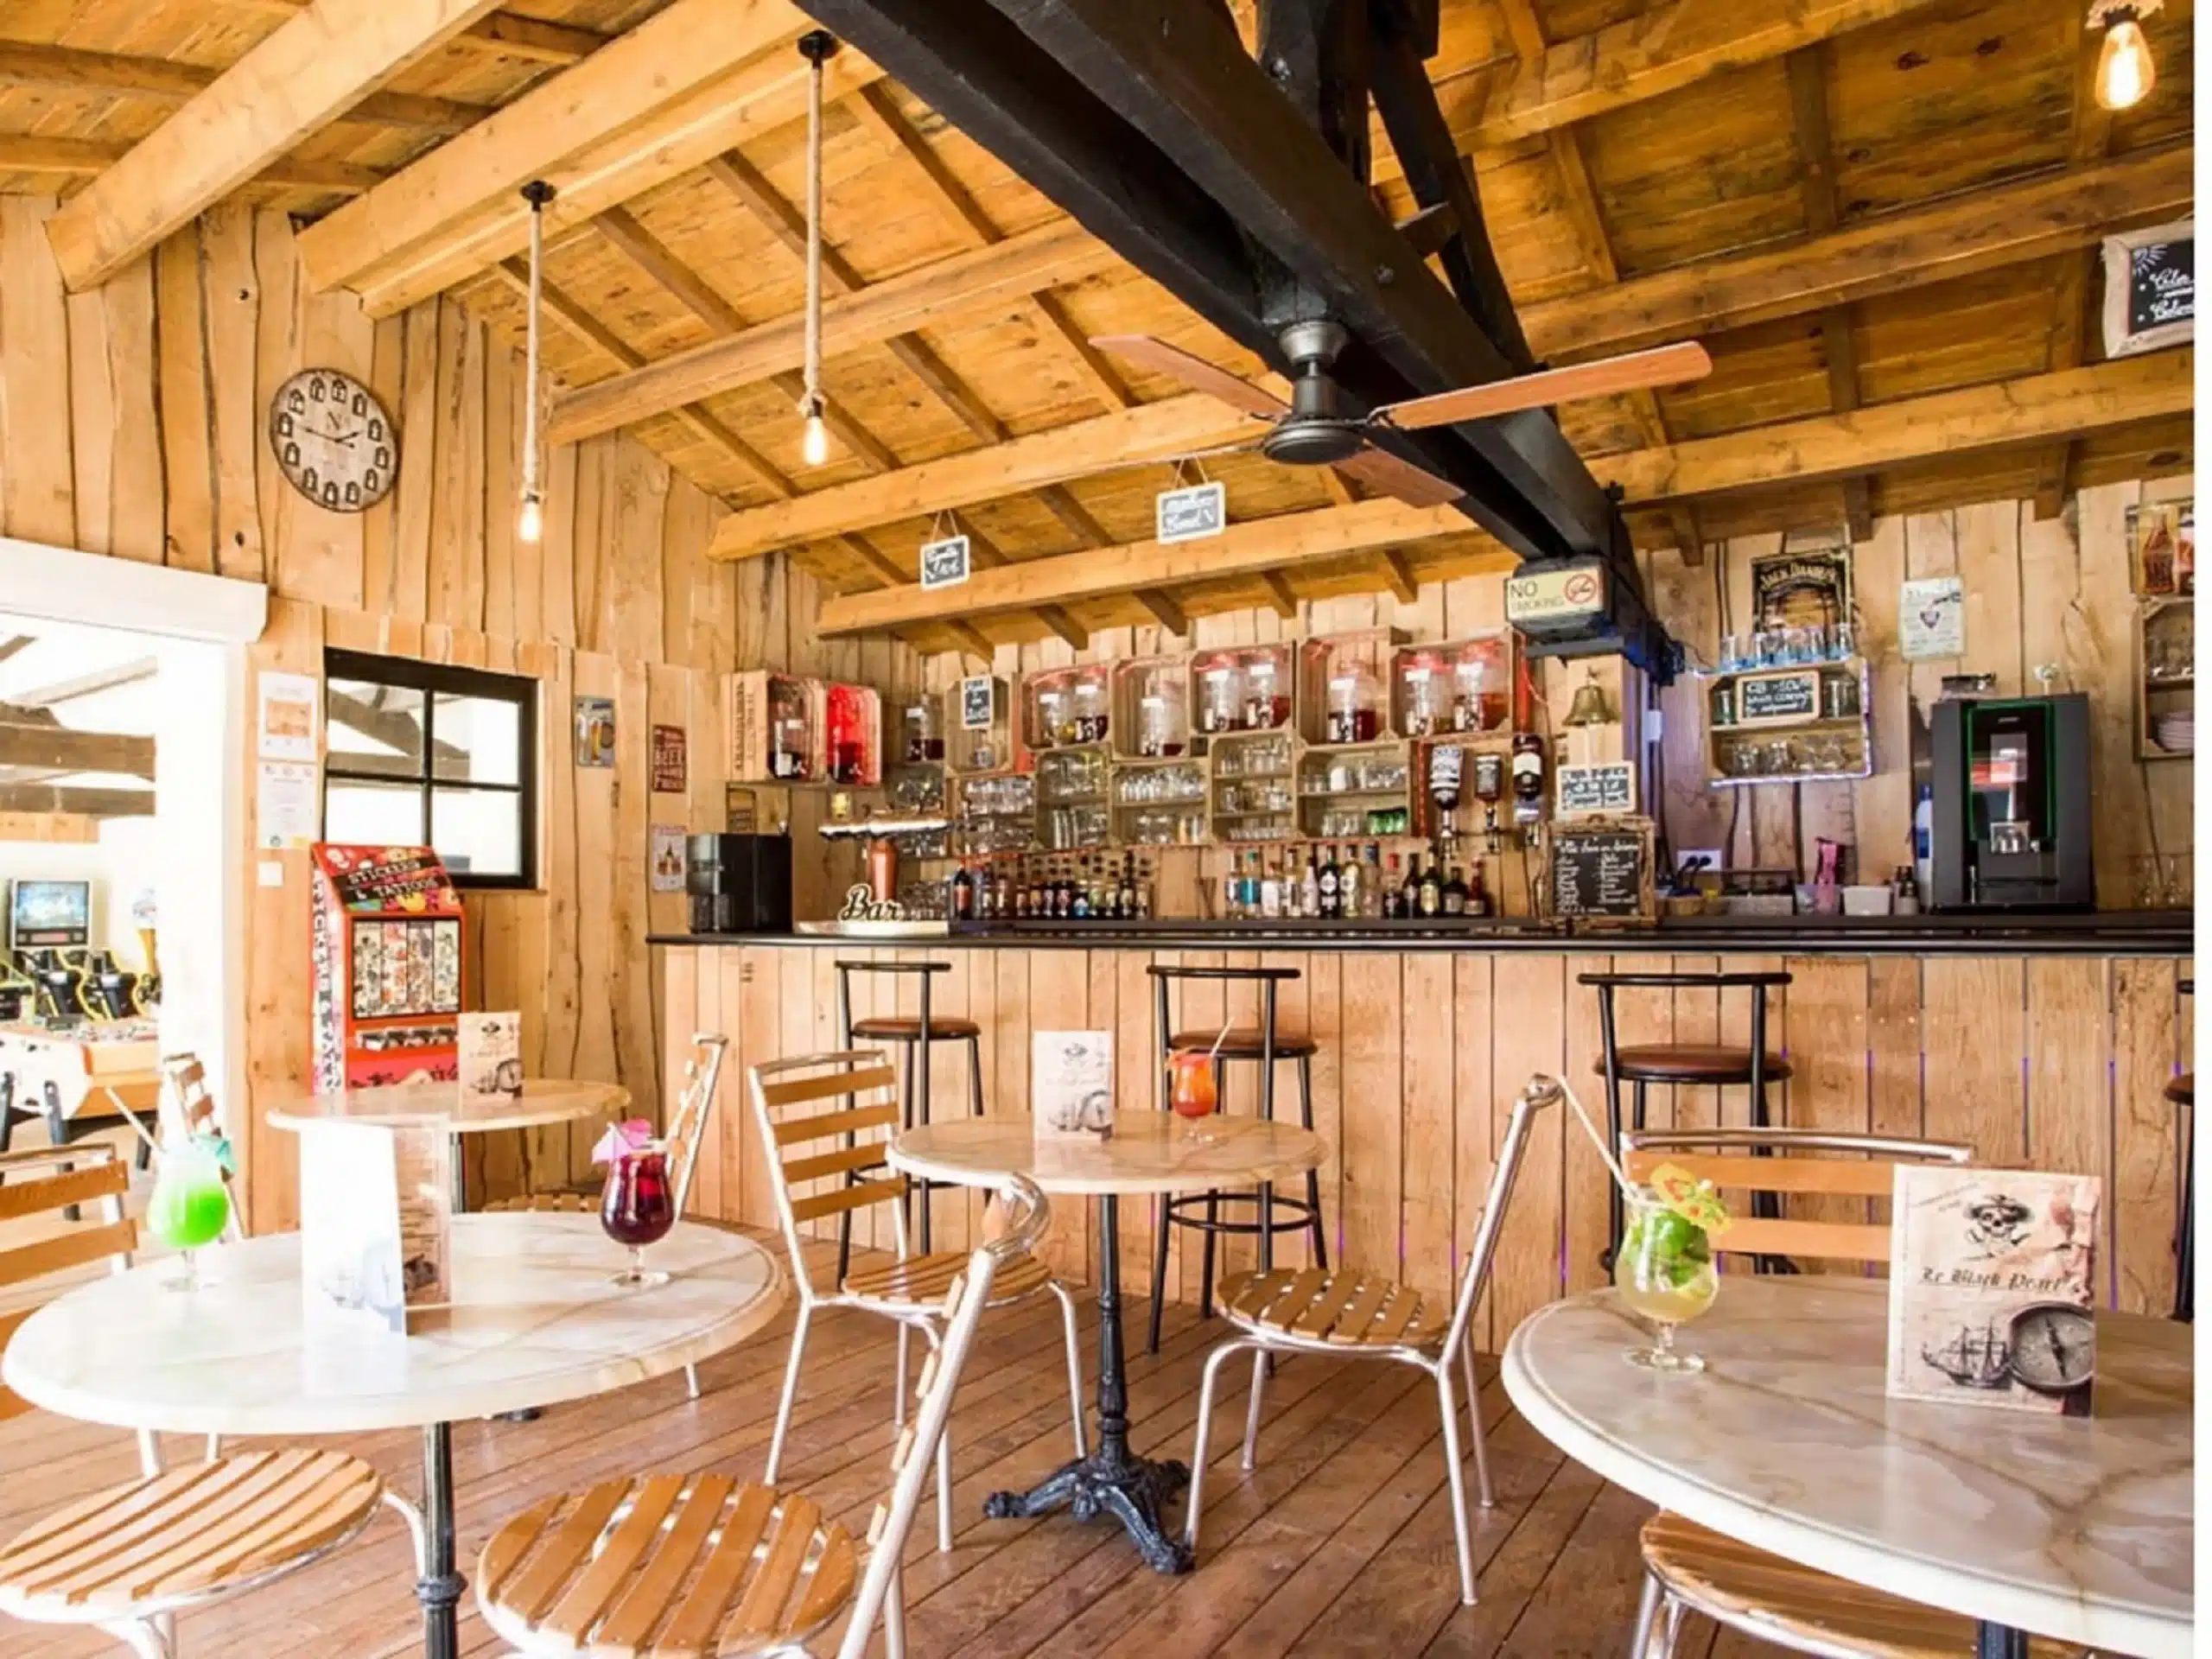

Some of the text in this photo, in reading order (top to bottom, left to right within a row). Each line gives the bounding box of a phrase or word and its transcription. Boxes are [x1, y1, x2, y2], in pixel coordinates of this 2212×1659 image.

[1510, 580, 1538, 599] NO
[1512, 594, 1565, 613] SMOKING
[348, 861, 421, 885] STICKERS
[372, 879, 438, 898] TATTOOS
[840, 883, 901, 921] Bar
[1951, 1268, 2002, 1292] Black
